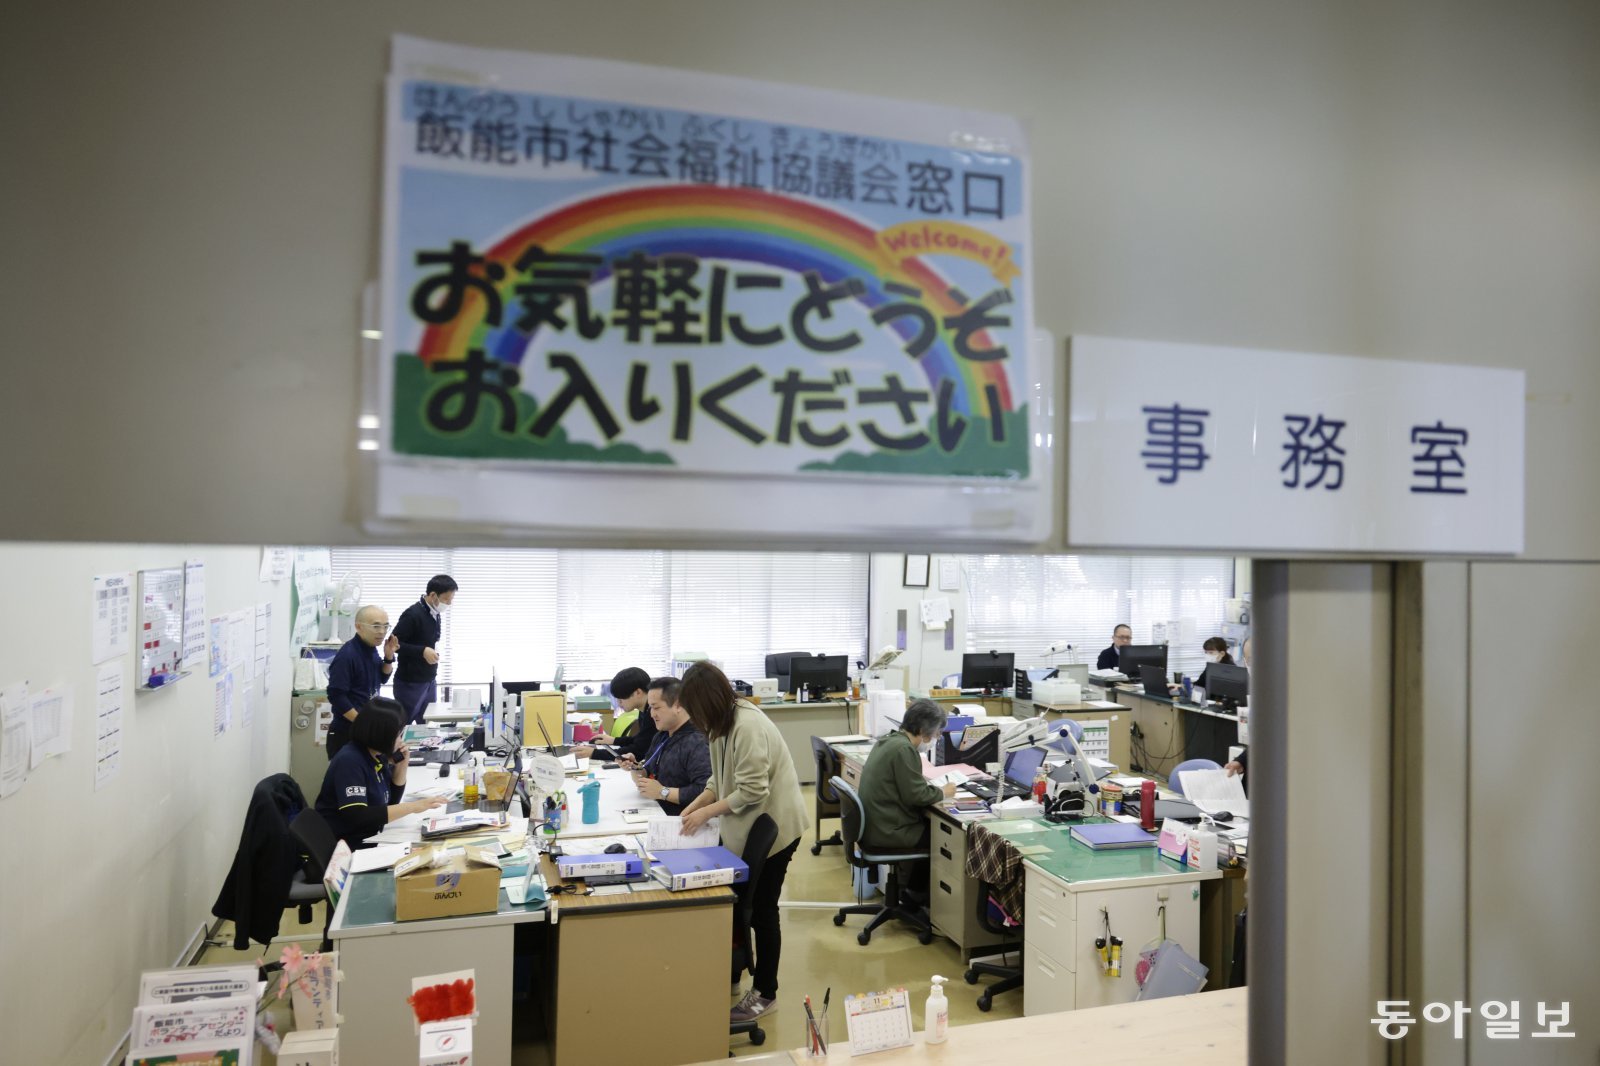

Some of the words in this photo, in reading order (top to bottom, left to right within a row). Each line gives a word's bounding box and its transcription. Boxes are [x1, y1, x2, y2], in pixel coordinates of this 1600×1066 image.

[884, 225, 1006, 260] Welcome!
[410, 239, 1014, 362] お気軽にどうぞ
[425, 349, 1006, 452] お入りください
